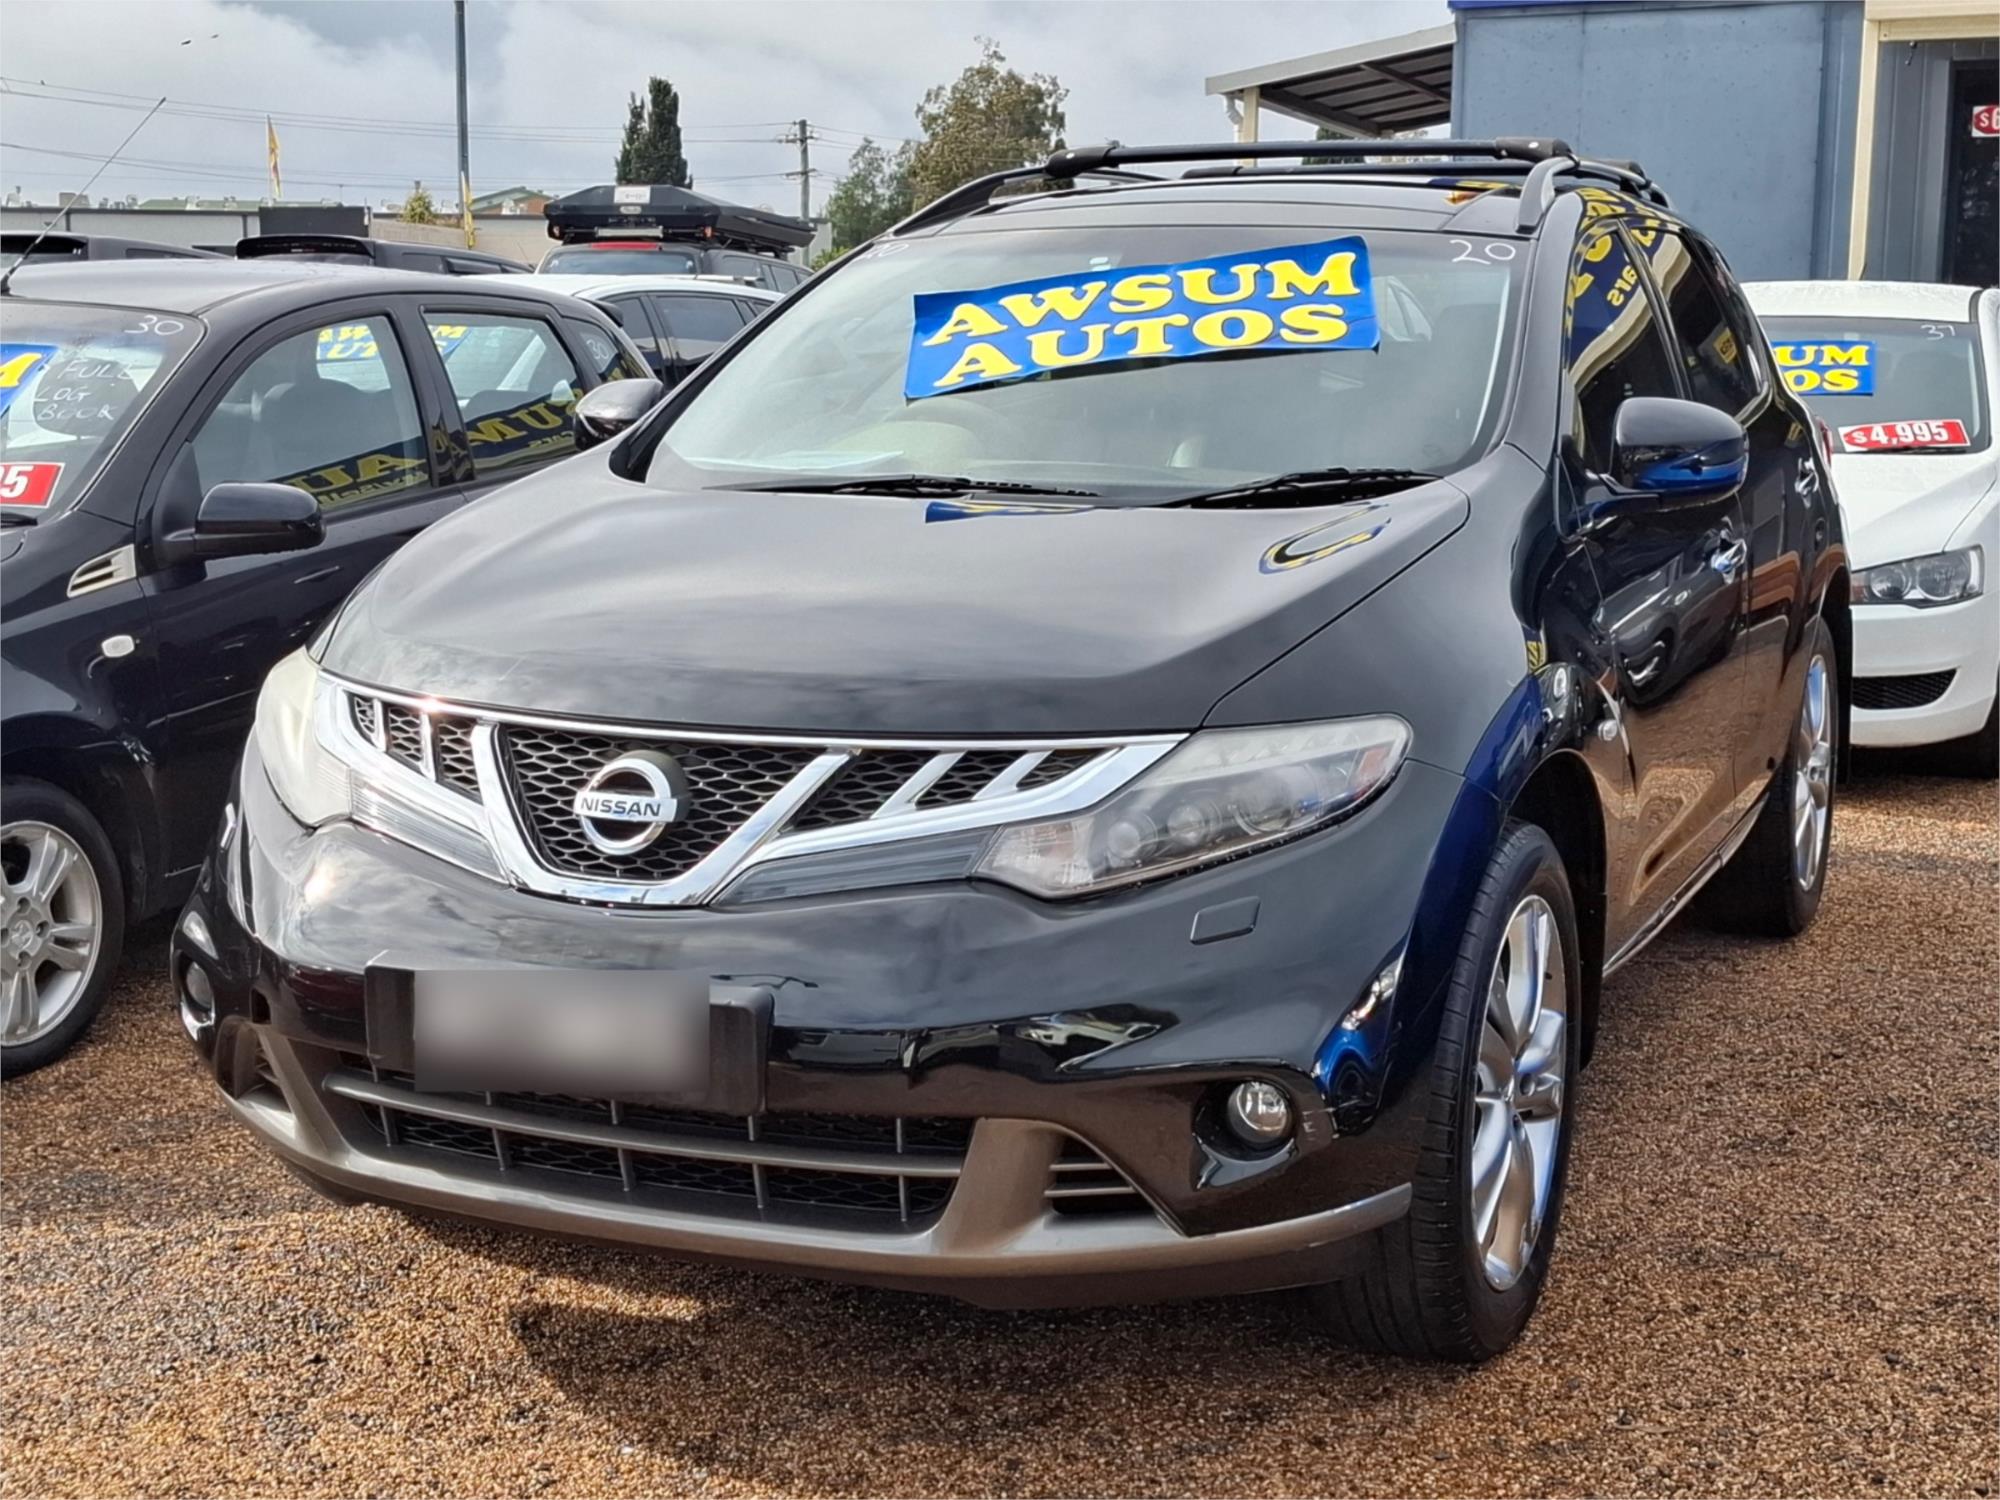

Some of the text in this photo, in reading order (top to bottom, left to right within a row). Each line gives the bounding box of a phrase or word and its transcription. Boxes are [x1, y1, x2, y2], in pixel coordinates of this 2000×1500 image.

[1449, 239, 1516, 265] 20
[922, 252, 1361, 346] AWSUM
[124, 315, 184, 335] 30
[933, 304, 1349, 387] AUTOS
[57, 359, 134, 380] FULL
[34, 386, 92, 402] LOG
[37, 403, 116, 421] BOOK
[1852, 421, 1948, 446] $4,995
[581, 798, 661, 817] NISSAN
